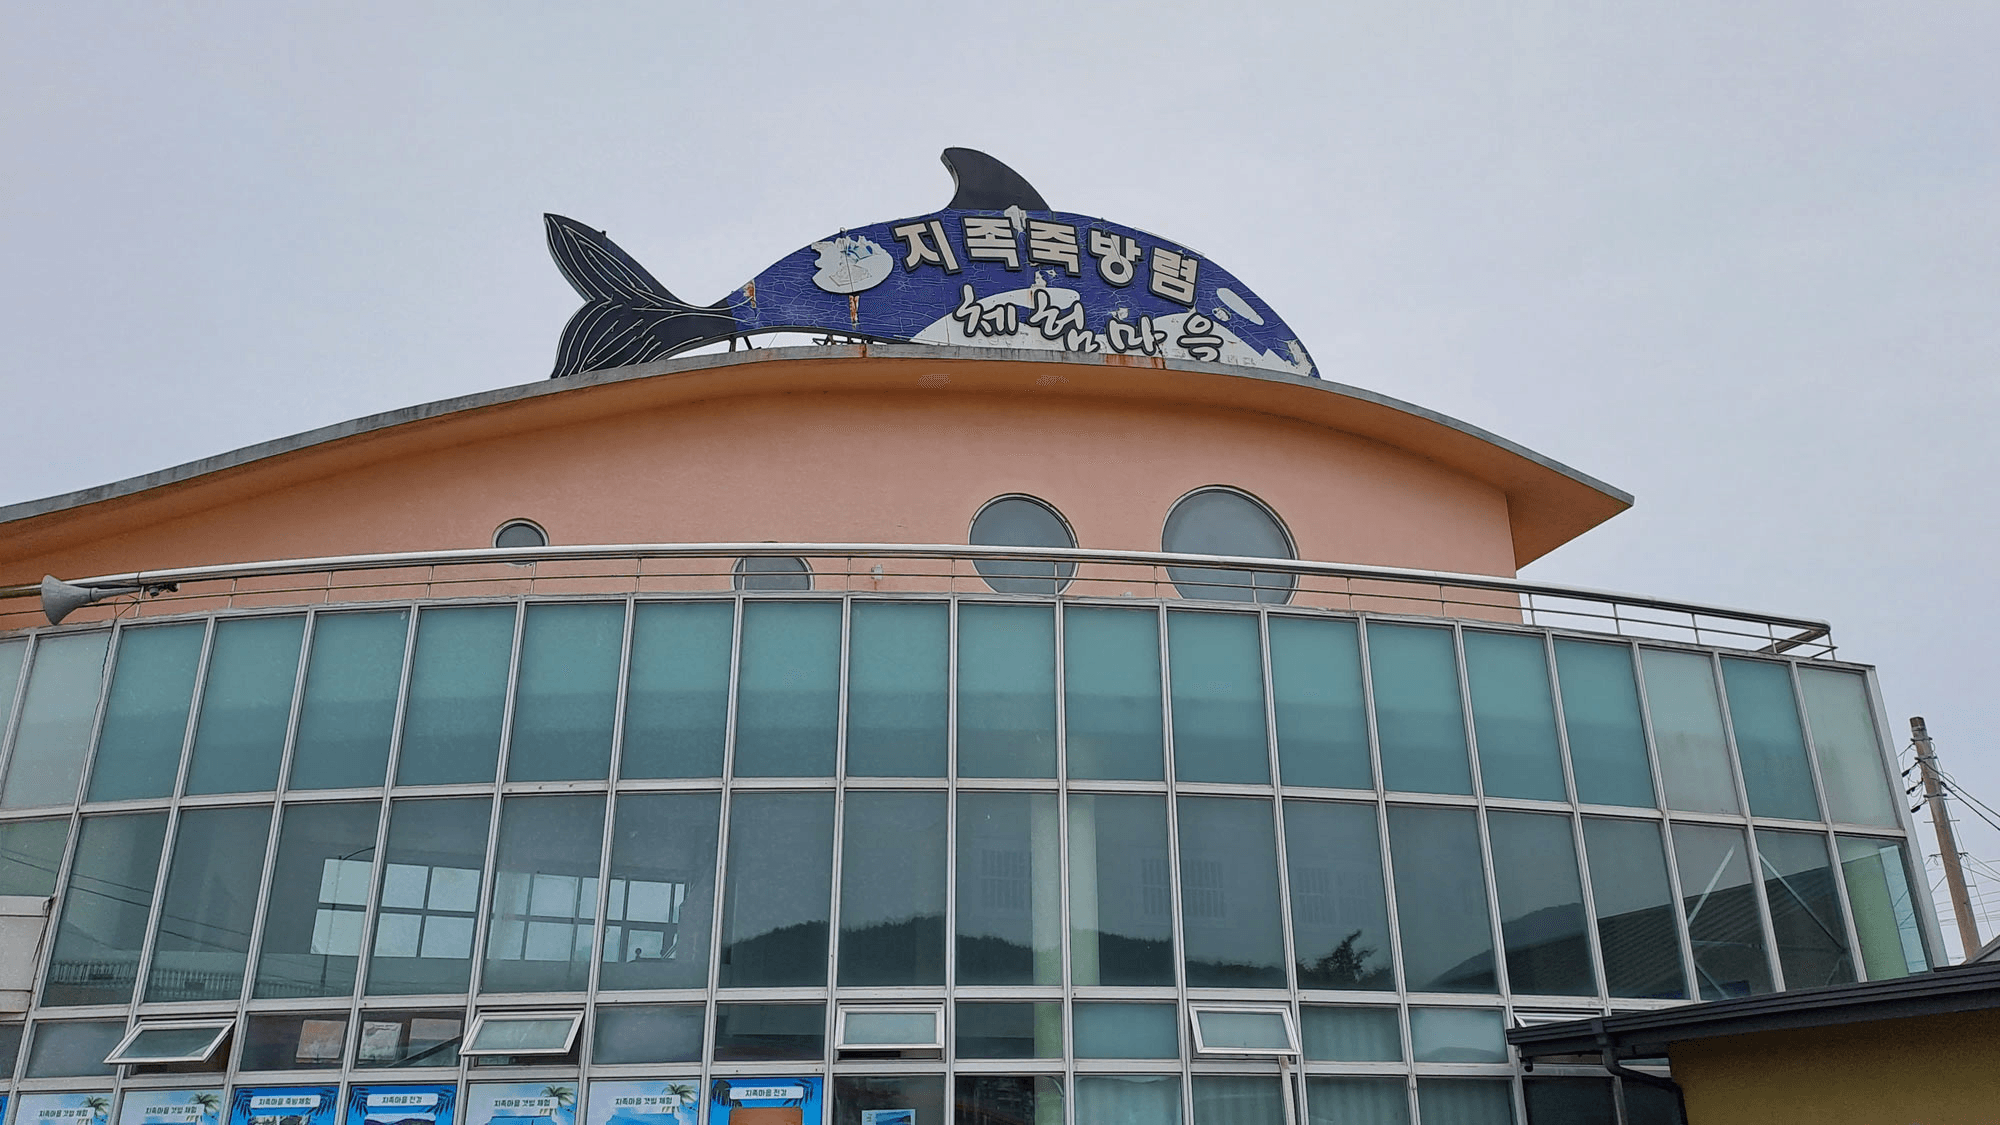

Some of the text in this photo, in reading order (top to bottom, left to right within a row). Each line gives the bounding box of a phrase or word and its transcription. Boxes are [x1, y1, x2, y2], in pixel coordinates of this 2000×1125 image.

[745, 1089, 772, 1097] 지족마을
[381, 1096, 408, 1104] 지족마을
[493, 1099, 520, 1107] 지족마을
[615, 1097, 642, 1105] 지족마을
[659, 1096, 673, 1105] 체험
